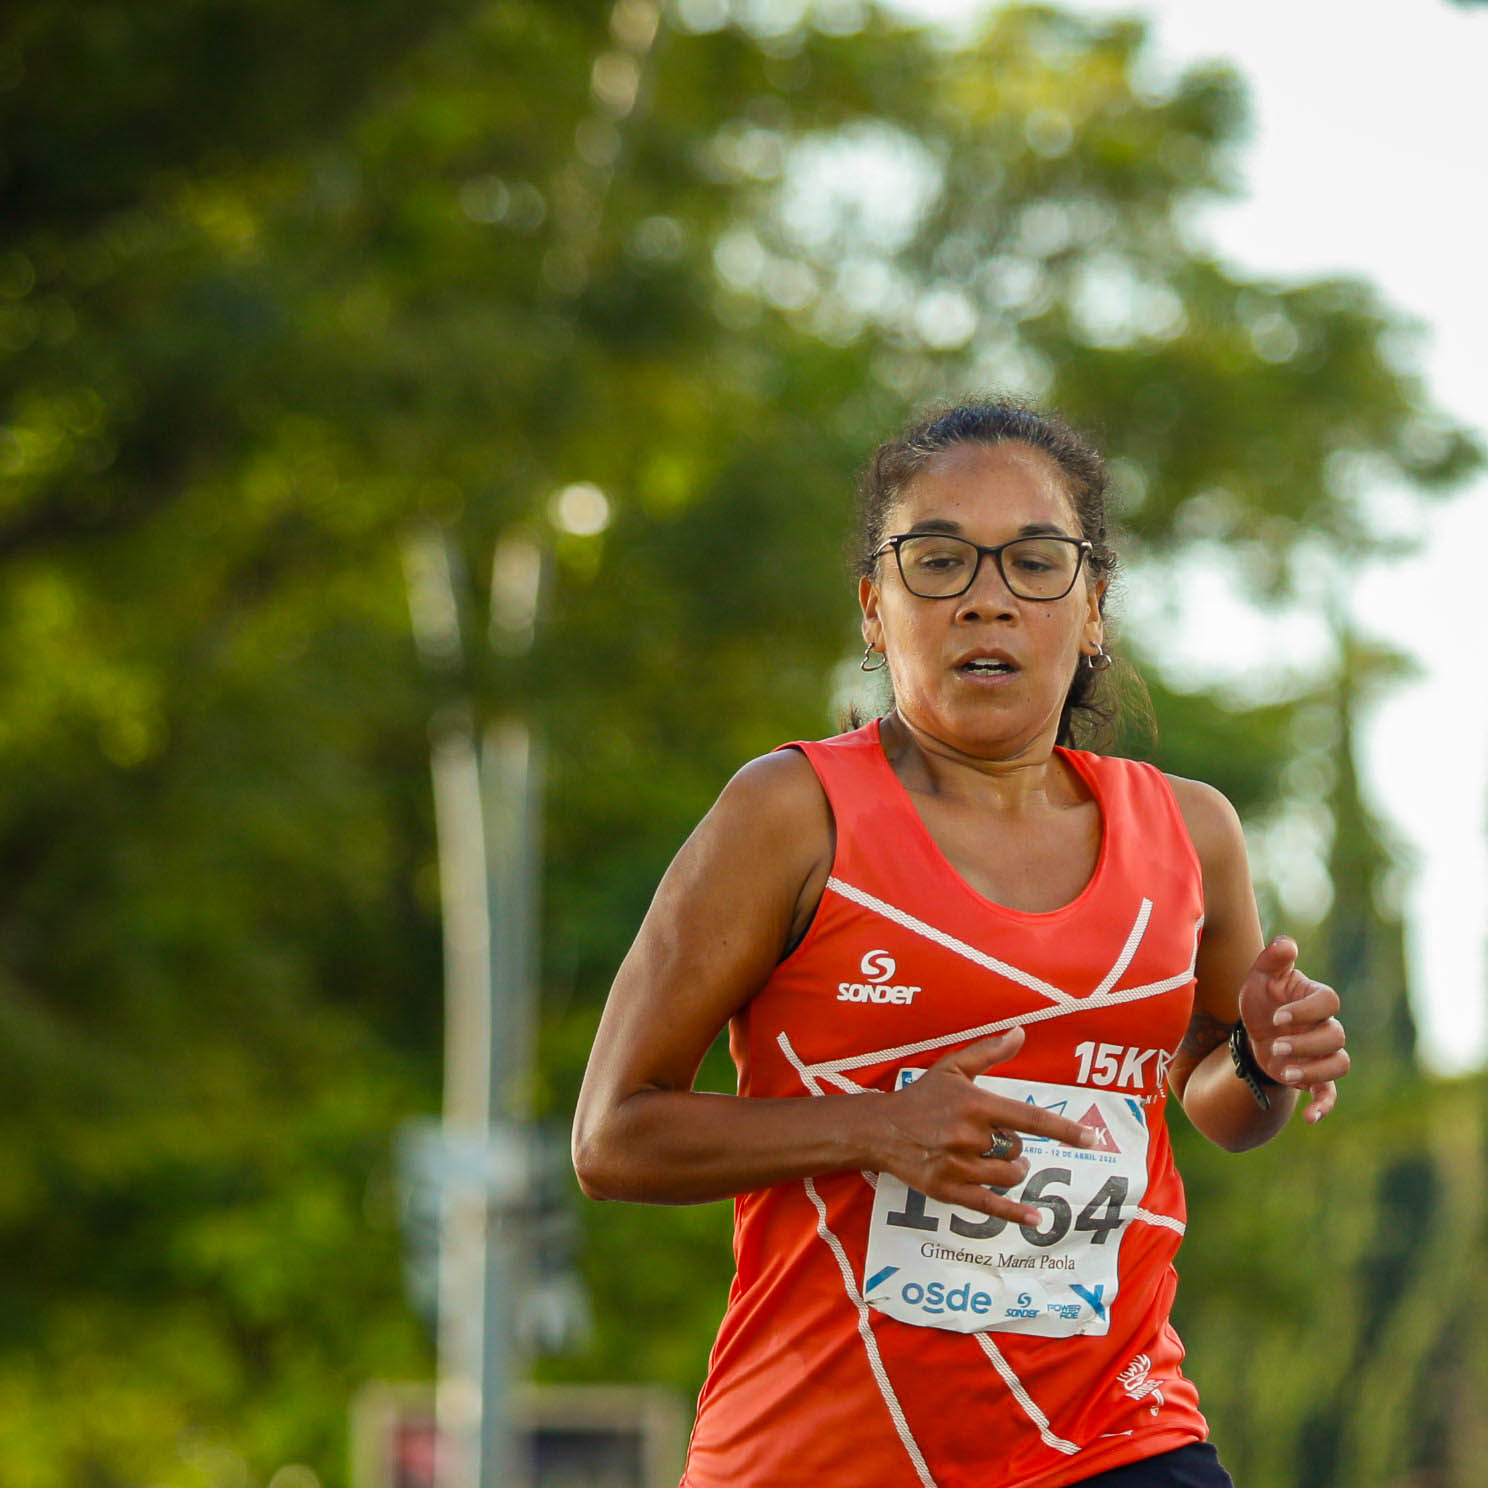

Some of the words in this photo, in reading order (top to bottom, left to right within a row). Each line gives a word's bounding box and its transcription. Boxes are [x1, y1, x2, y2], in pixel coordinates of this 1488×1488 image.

[1074, 1040, 1158, 1089] 15K
[1023, 1146, 1043, 1154] ARIO
[1051, 1149, 1060, 1157] 12
[1074, 1152, 1096, 1161] ABRIL
[920, 1242, 993, 1267] Giménez
[998, 1252, 1036, 1270] María
[1039, 1254, 1075, 1270] Paola
